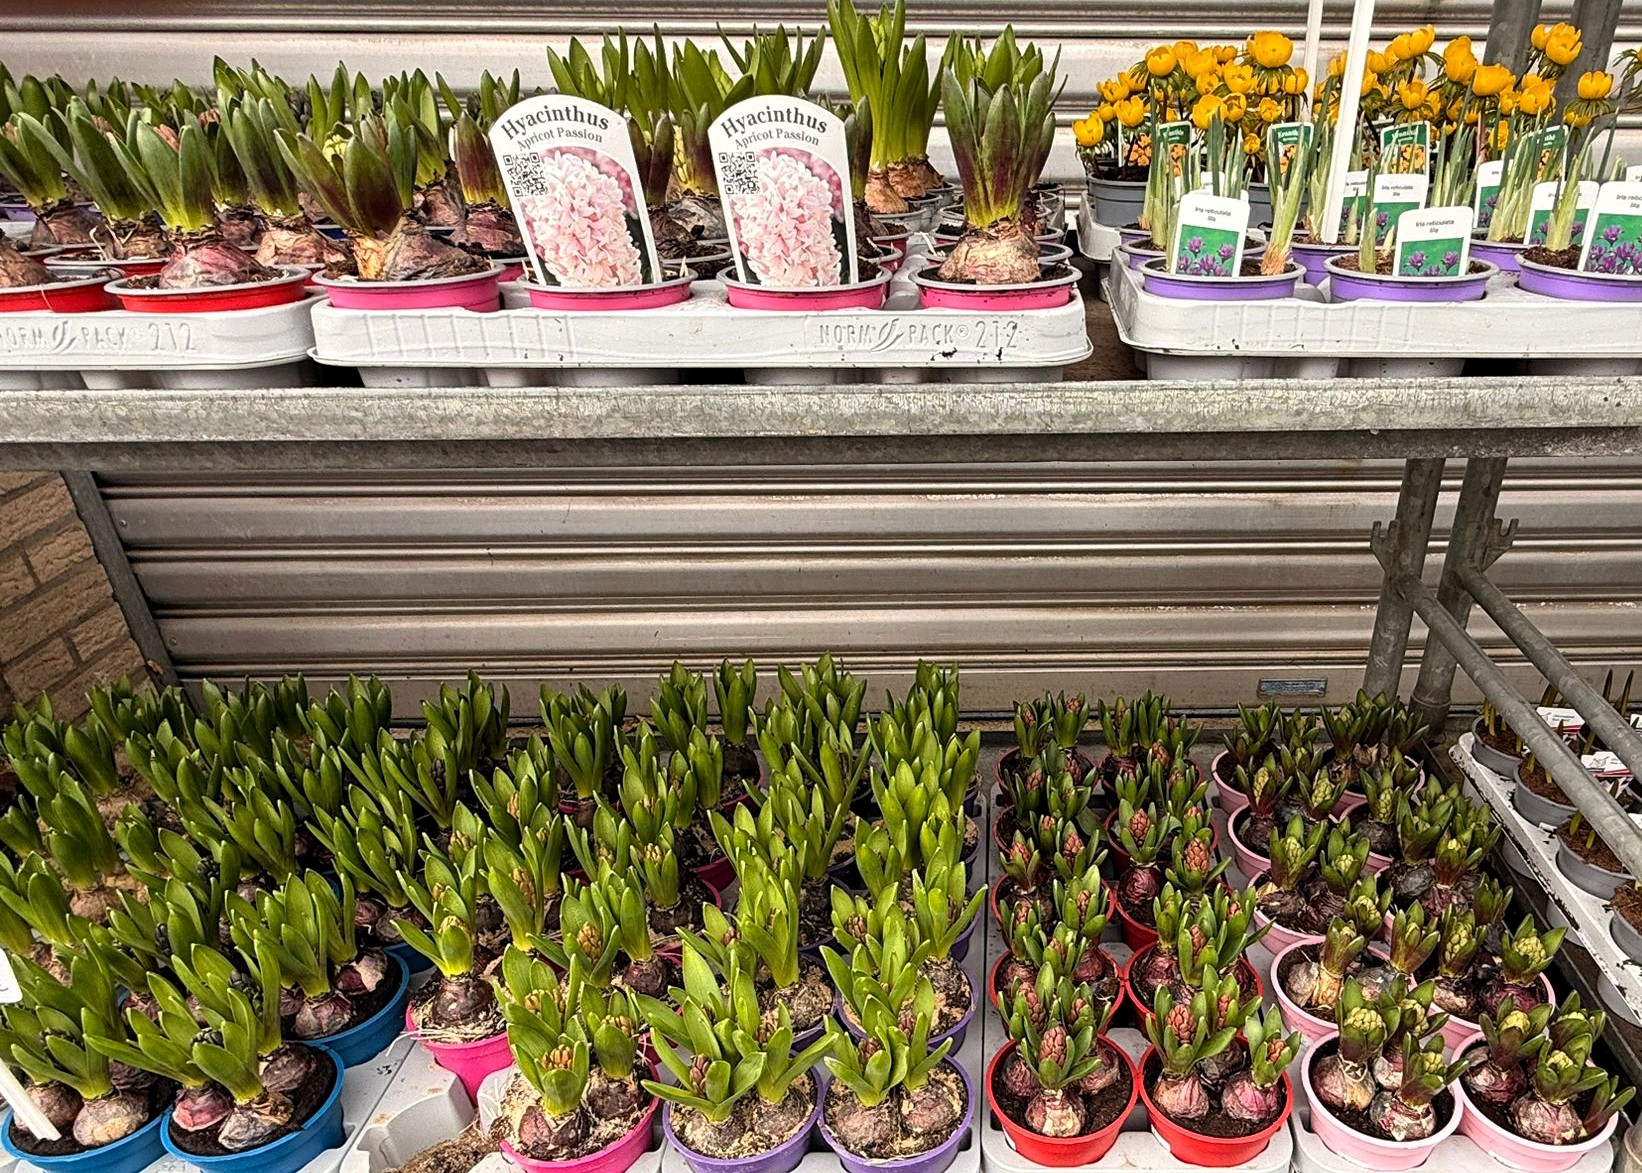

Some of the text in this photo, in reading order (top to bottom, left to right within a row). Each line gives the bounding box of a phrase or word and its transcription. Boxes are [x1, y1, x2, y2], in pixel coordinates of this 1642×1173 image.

[501, 105, 609, 140] Hyacinthus
[720, 105, 828, 138] Hyacinthus
[517, 127, 603, 151] Apricot Passion
[735, 128, 820, 150] Apricot Passion
[975, 320, 1018, 349] 212
